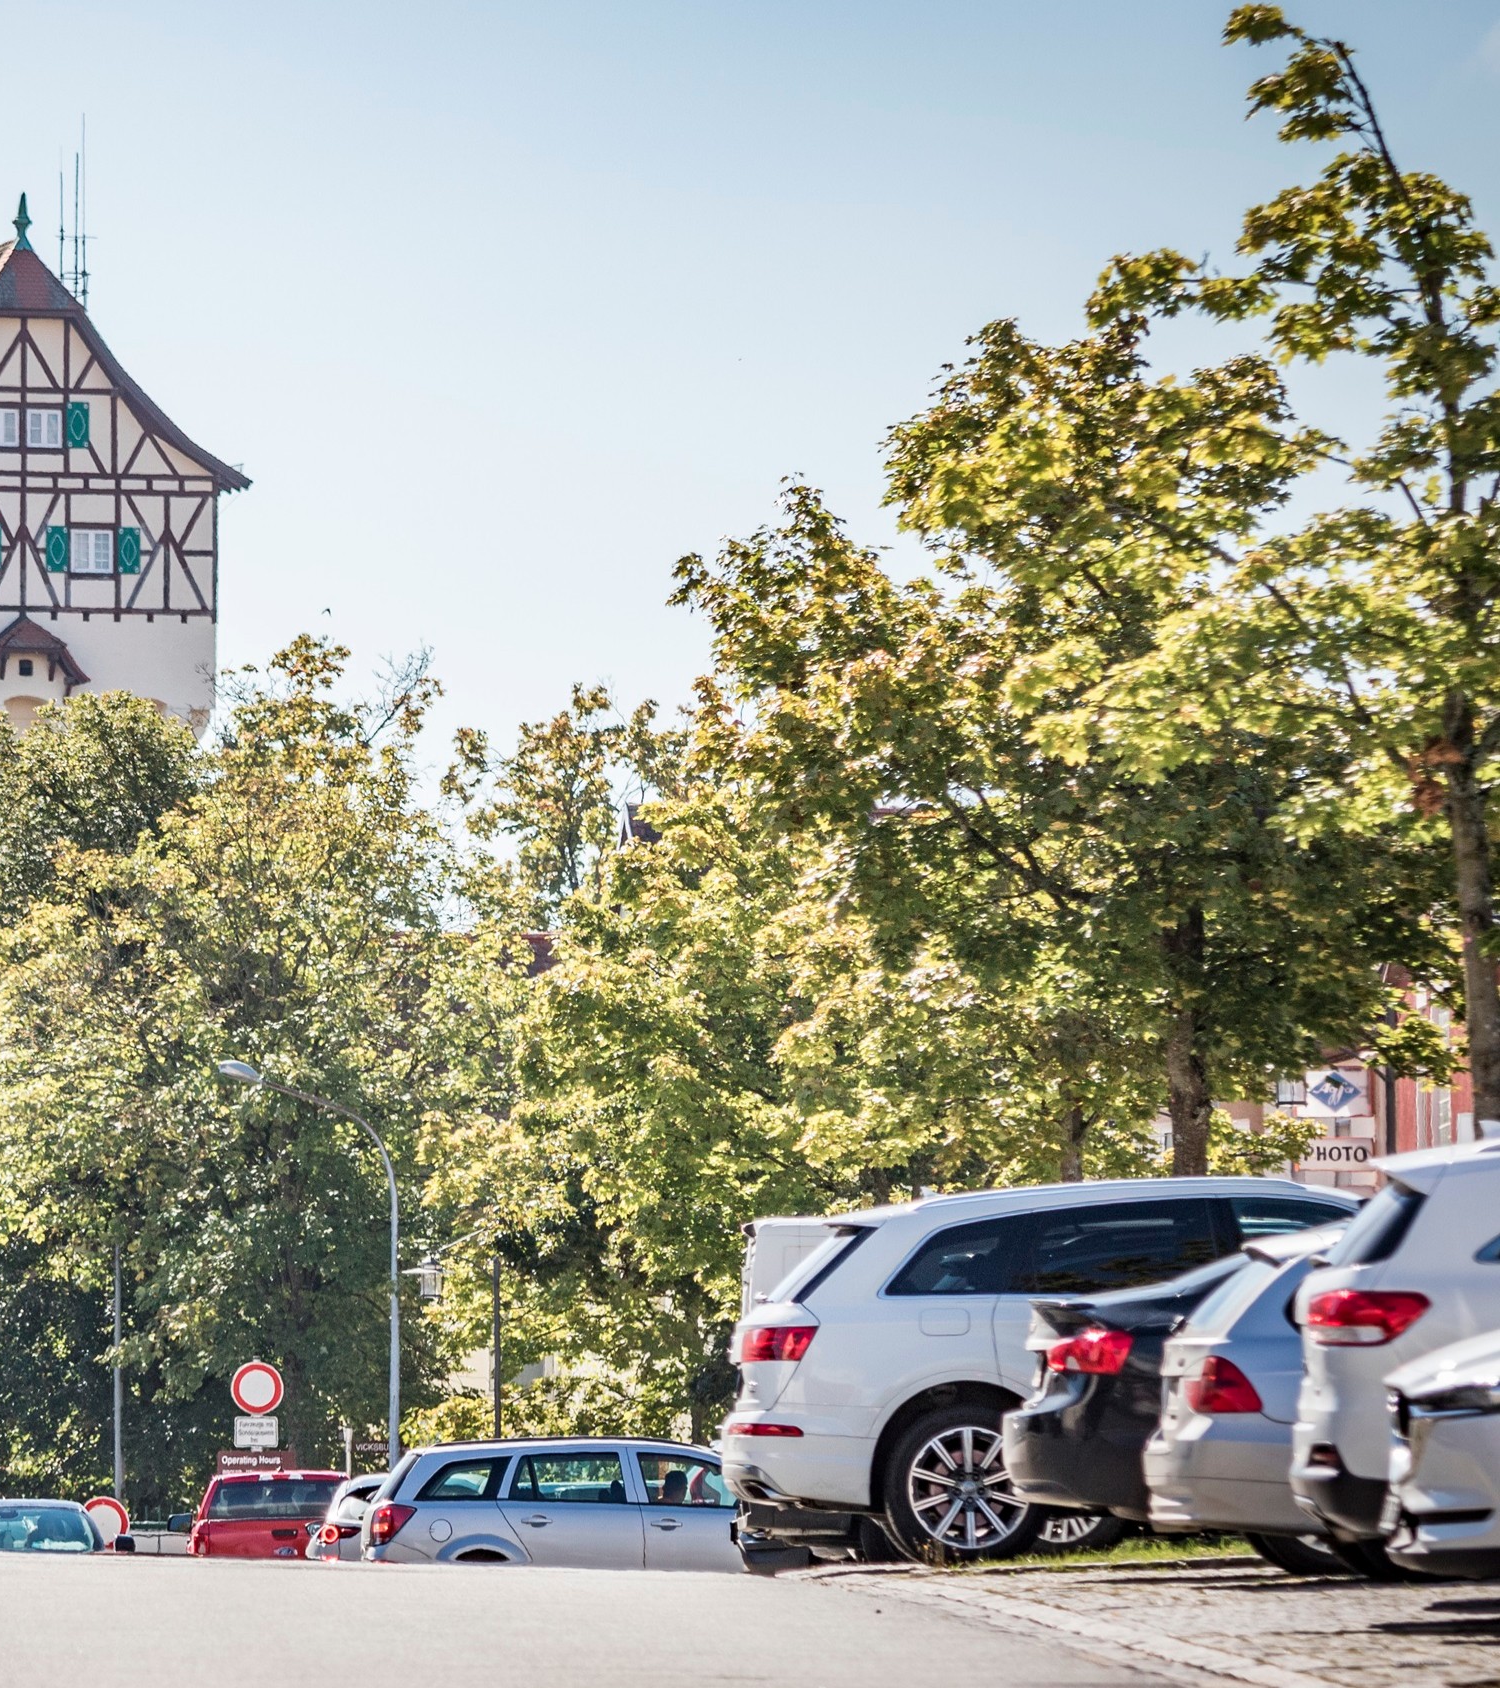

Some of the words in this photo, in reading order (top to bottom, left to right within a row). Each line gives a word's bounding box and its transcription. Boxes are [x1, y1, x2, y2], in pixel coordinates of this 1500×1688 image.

[355, 1443, 389, 1452] VICKSBU
[221, 1455, 258, 1467] Operating
[259, 1455, 281, 1465] Hours
